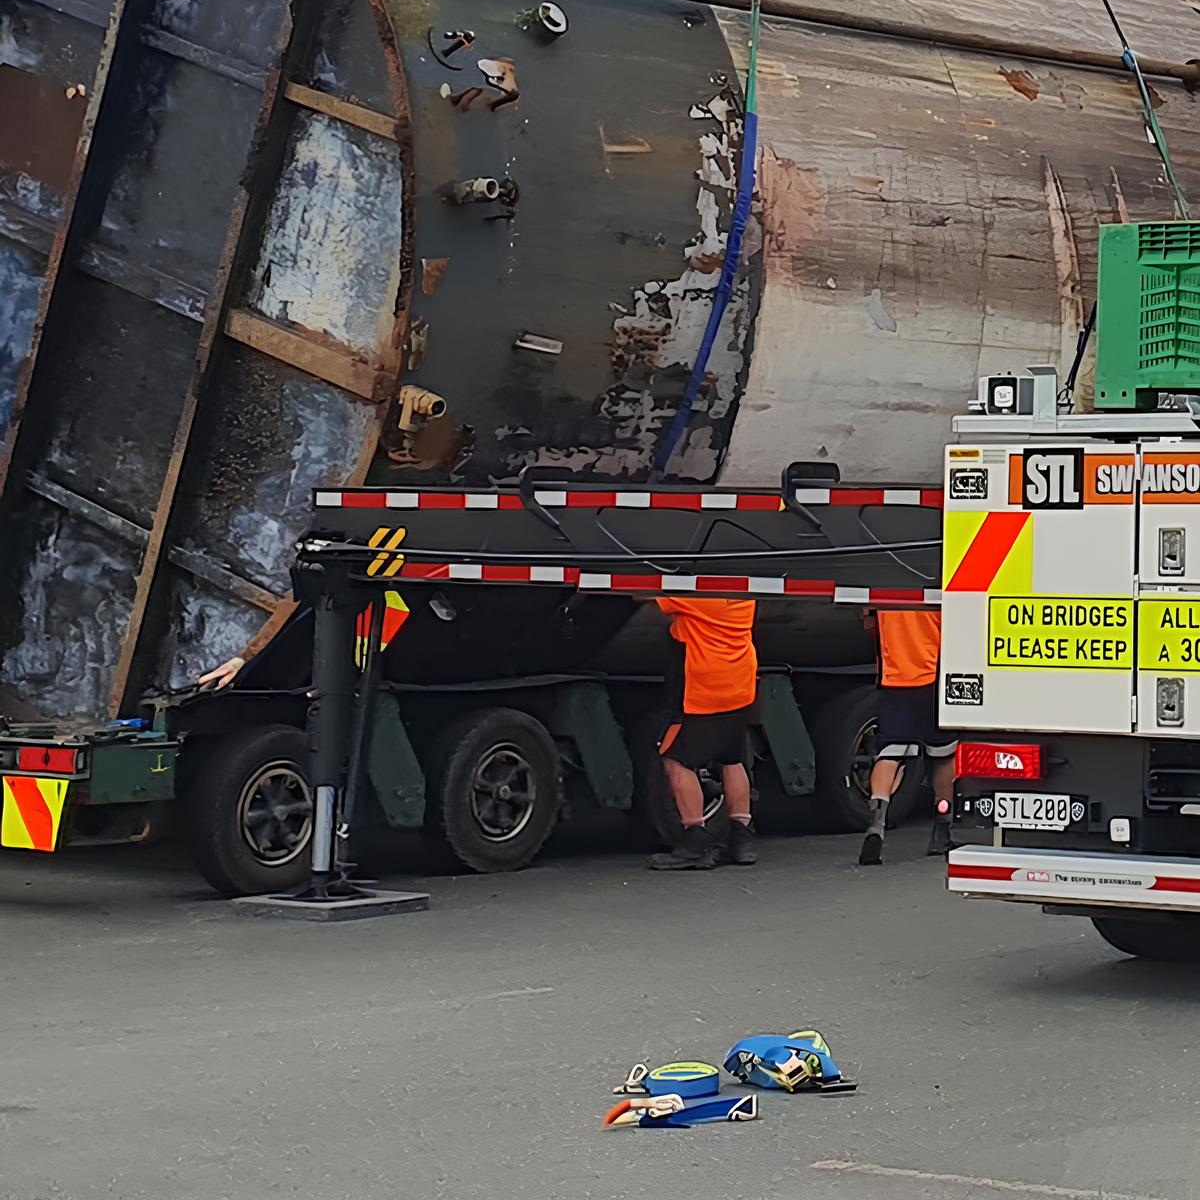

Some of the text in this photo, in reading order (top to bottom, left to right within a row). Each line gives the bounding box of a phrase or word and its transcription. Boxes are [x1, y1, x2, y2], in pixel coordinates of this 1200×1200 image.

[1026, 454, 1080, 504] STL
[1007, 604, 1034, 626] ON
[1042, 605, 1127, 627] BRIDGES
[1160, 607, 1200, 629] ALL
[994, 637, 1069, 660] PLEASE
[1076, 638, 1127, 661] KEEP
